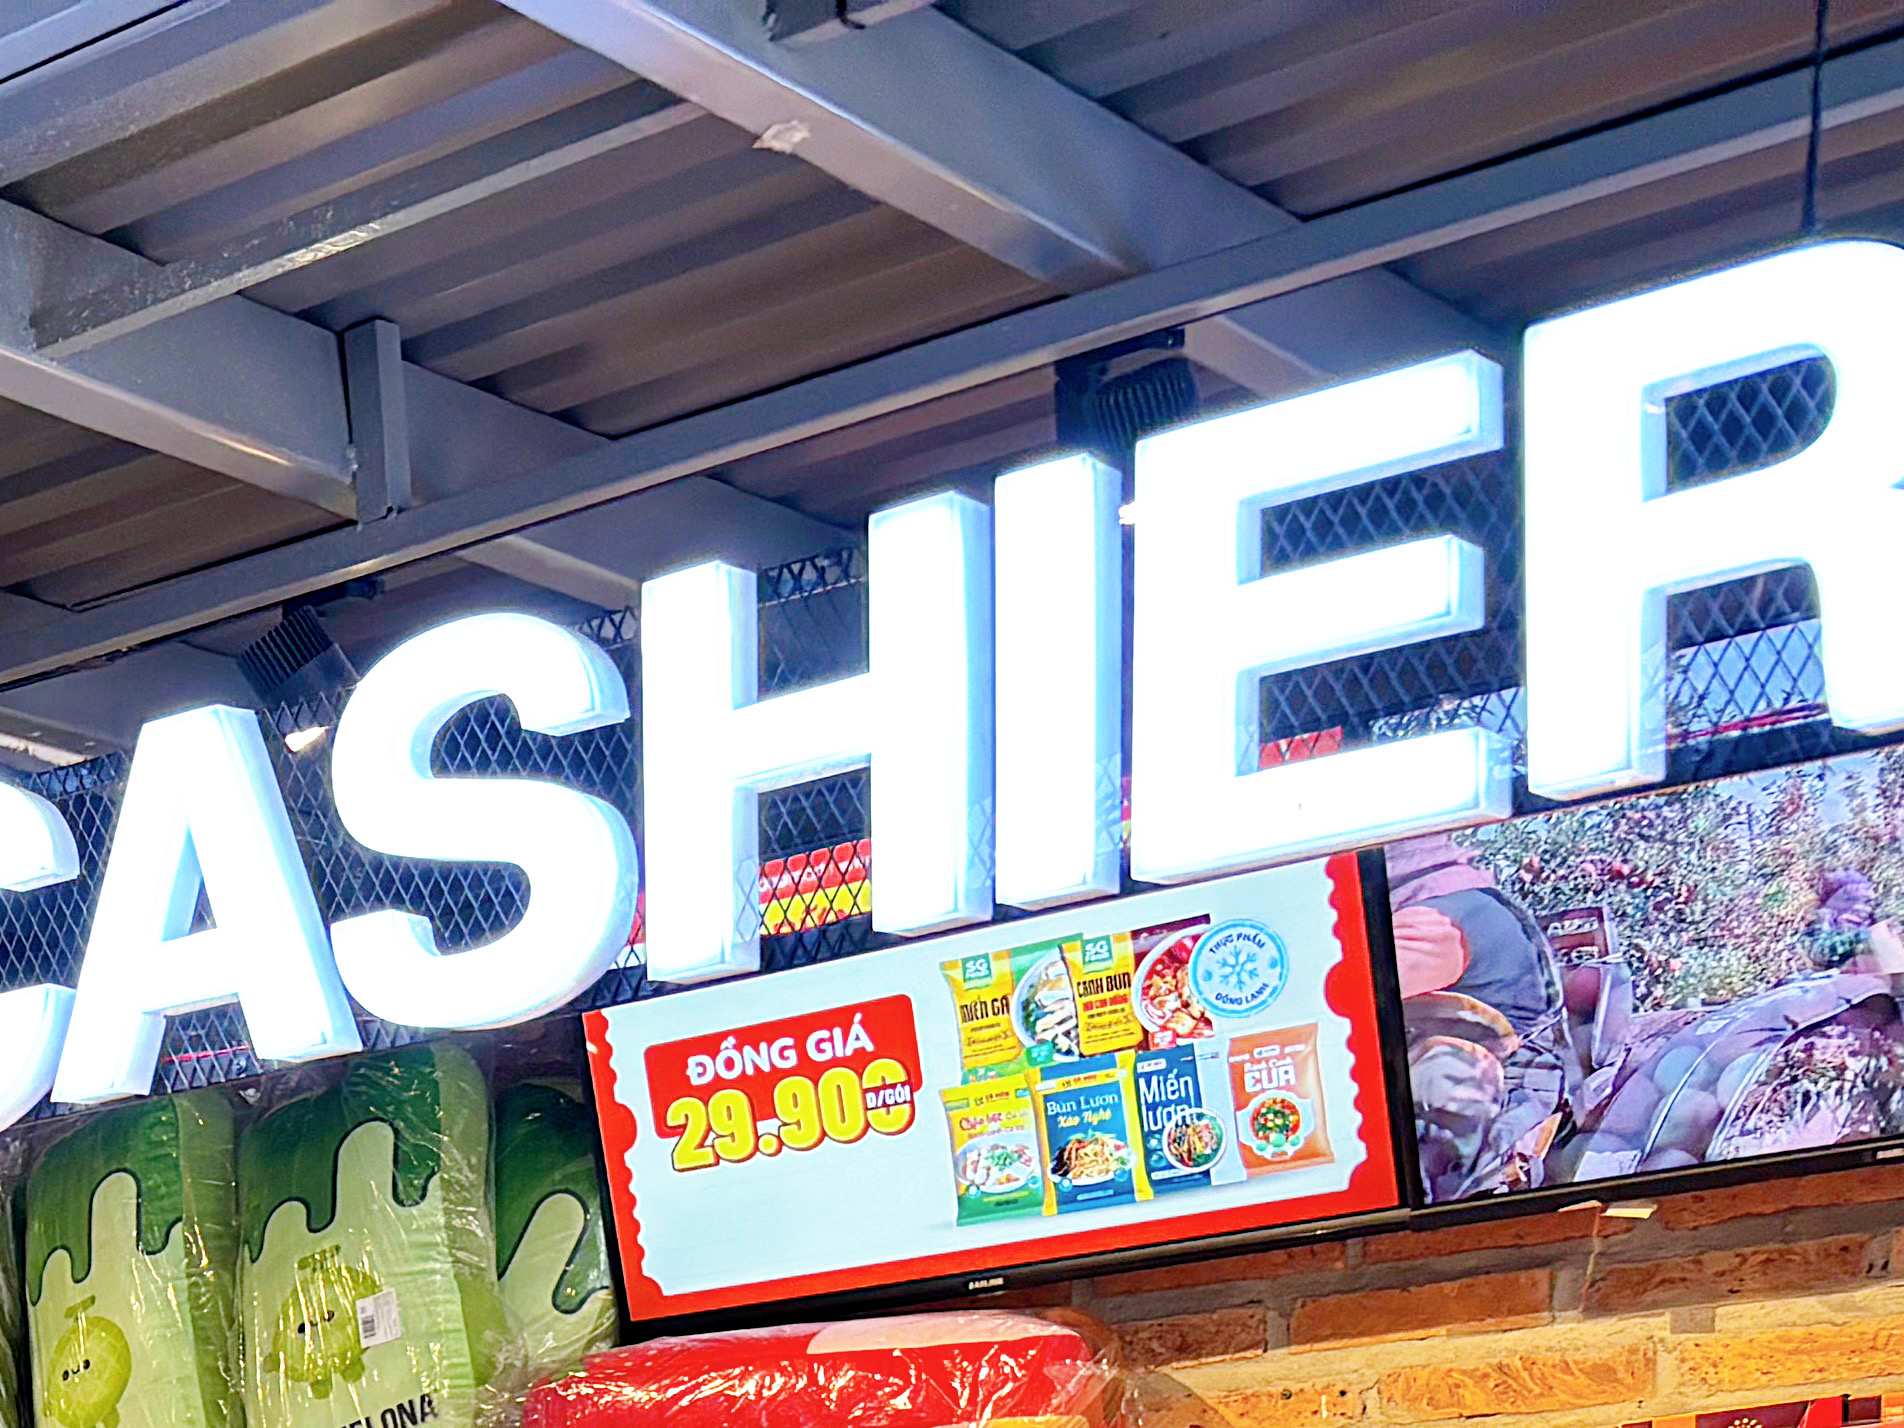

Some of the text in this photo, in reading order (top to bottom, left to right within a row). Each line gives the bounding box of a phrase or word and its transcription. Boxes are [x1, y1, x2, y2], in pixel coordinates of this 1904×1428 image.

[686, 1013, 874, 1086] ĐỒNG GIÁ
[667, 1058, 915, 1172] 29.900
